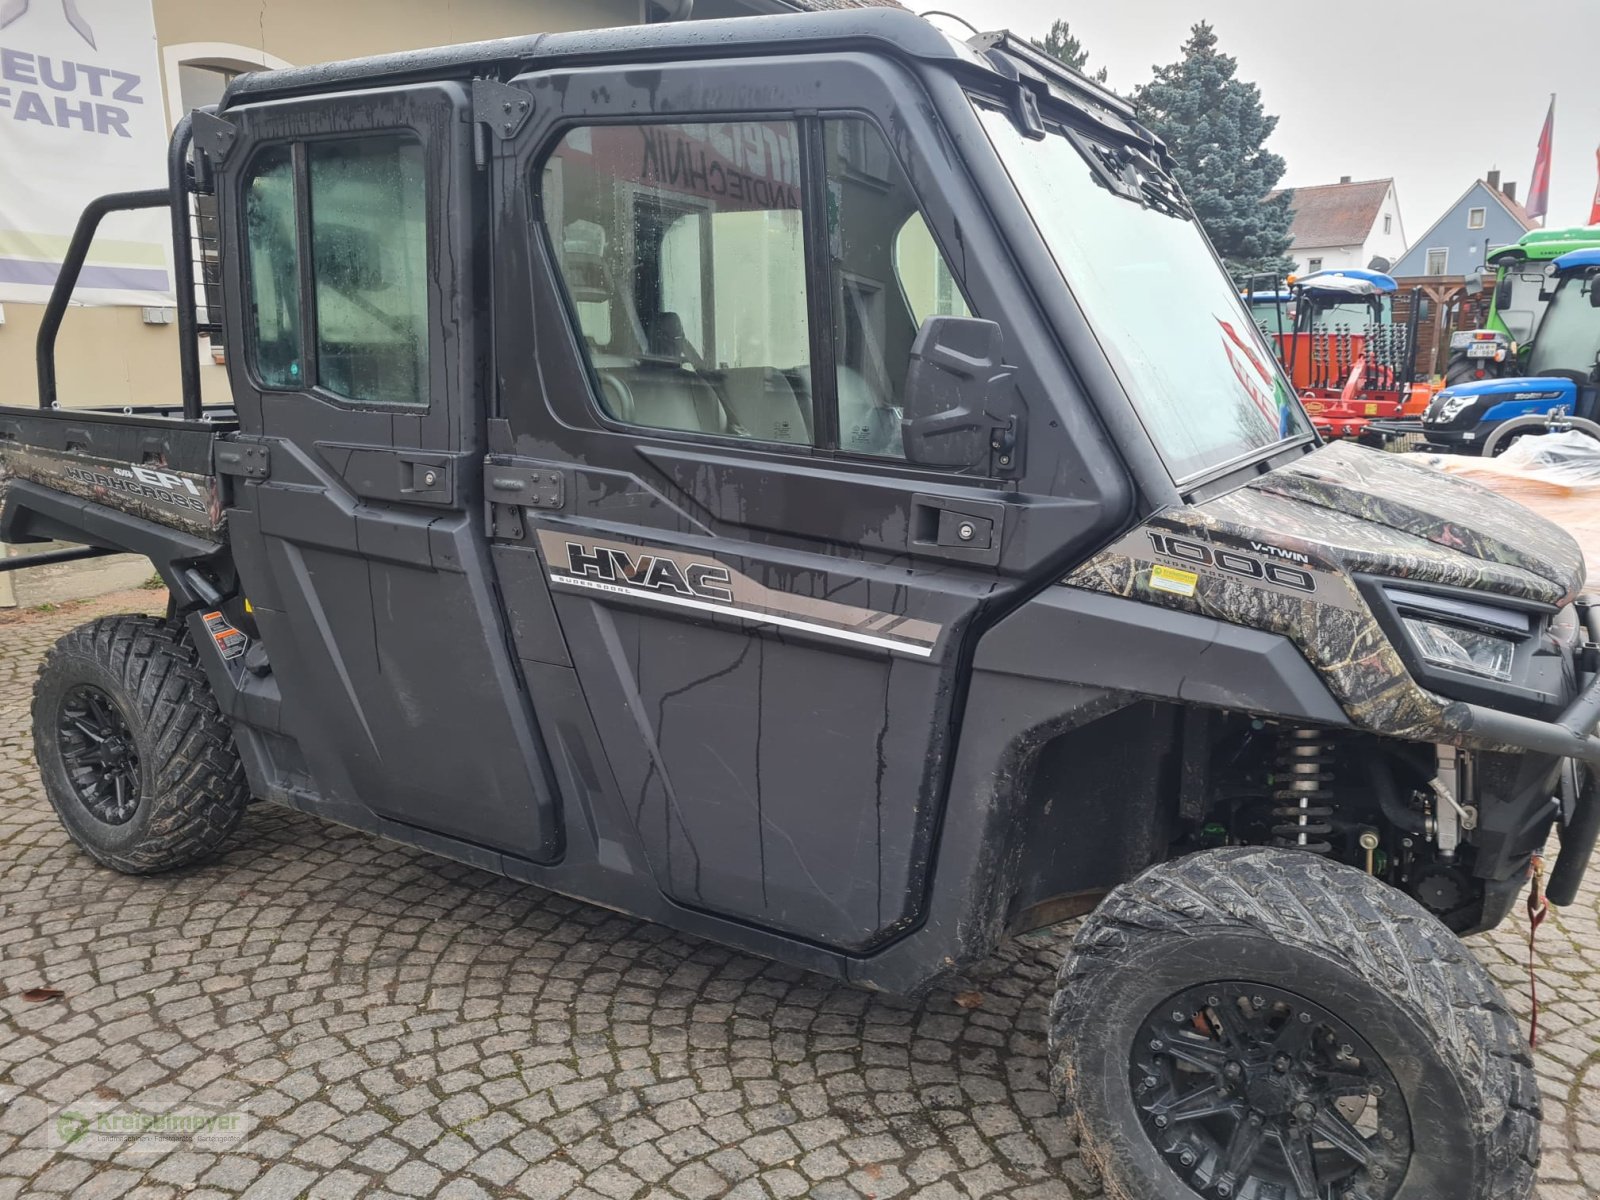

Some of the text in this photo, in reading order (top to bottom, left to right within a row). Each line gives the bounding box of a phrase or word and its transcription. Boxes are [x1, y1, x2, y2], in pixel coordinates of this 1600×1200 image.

[0, 48, 144, 104] EUTZ
[131, 466, 201, 496] EFI
[565, 541, 732, 603] HVAC
[1146, 530, 1317, 594] 1000
[1250, 541, 1309, 564] V-TWIN
